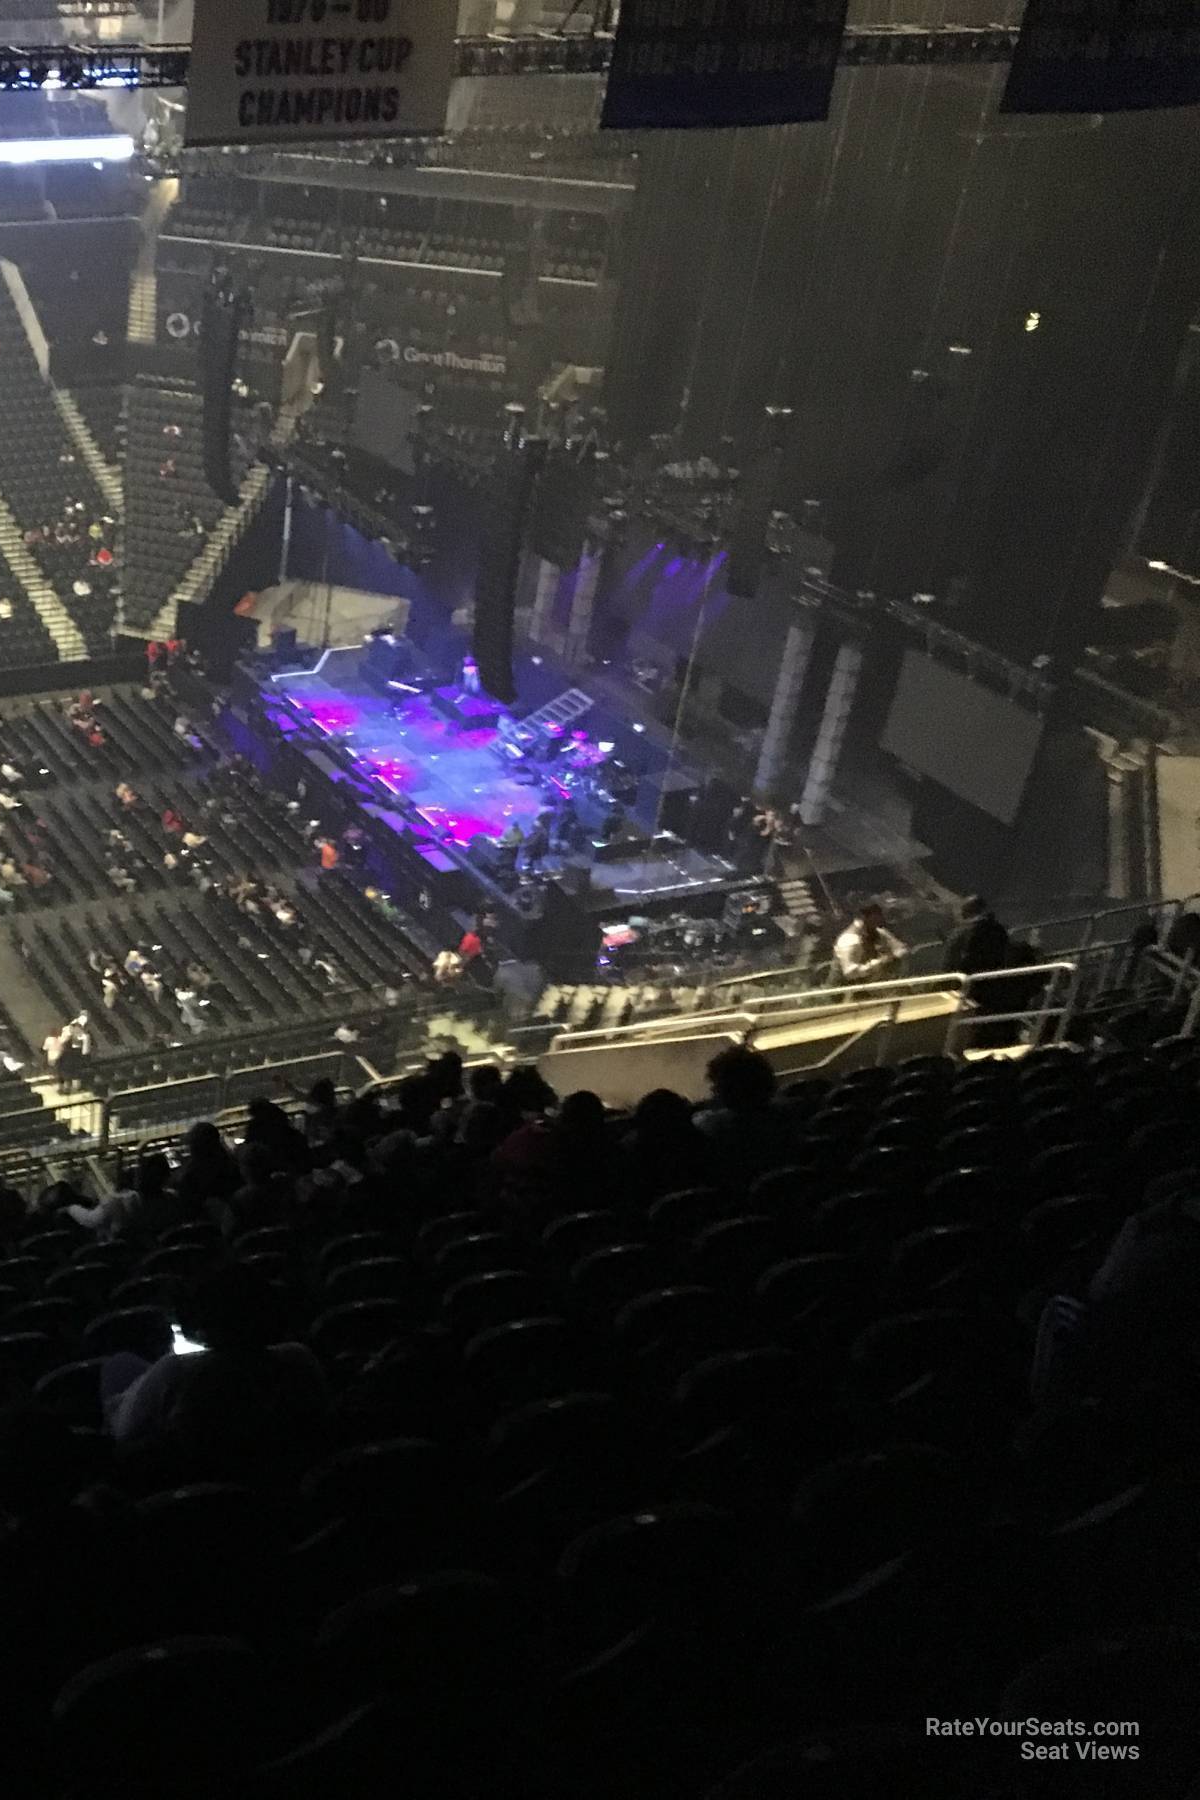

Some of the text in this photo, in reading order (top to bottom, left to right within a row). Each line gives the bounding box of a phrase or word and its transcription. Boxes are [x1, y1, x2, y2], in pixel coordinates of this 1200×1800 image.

[234, 36, 413, 76] STANLEY CUP
[238, 86, 400, 127] CHAMPIONS
